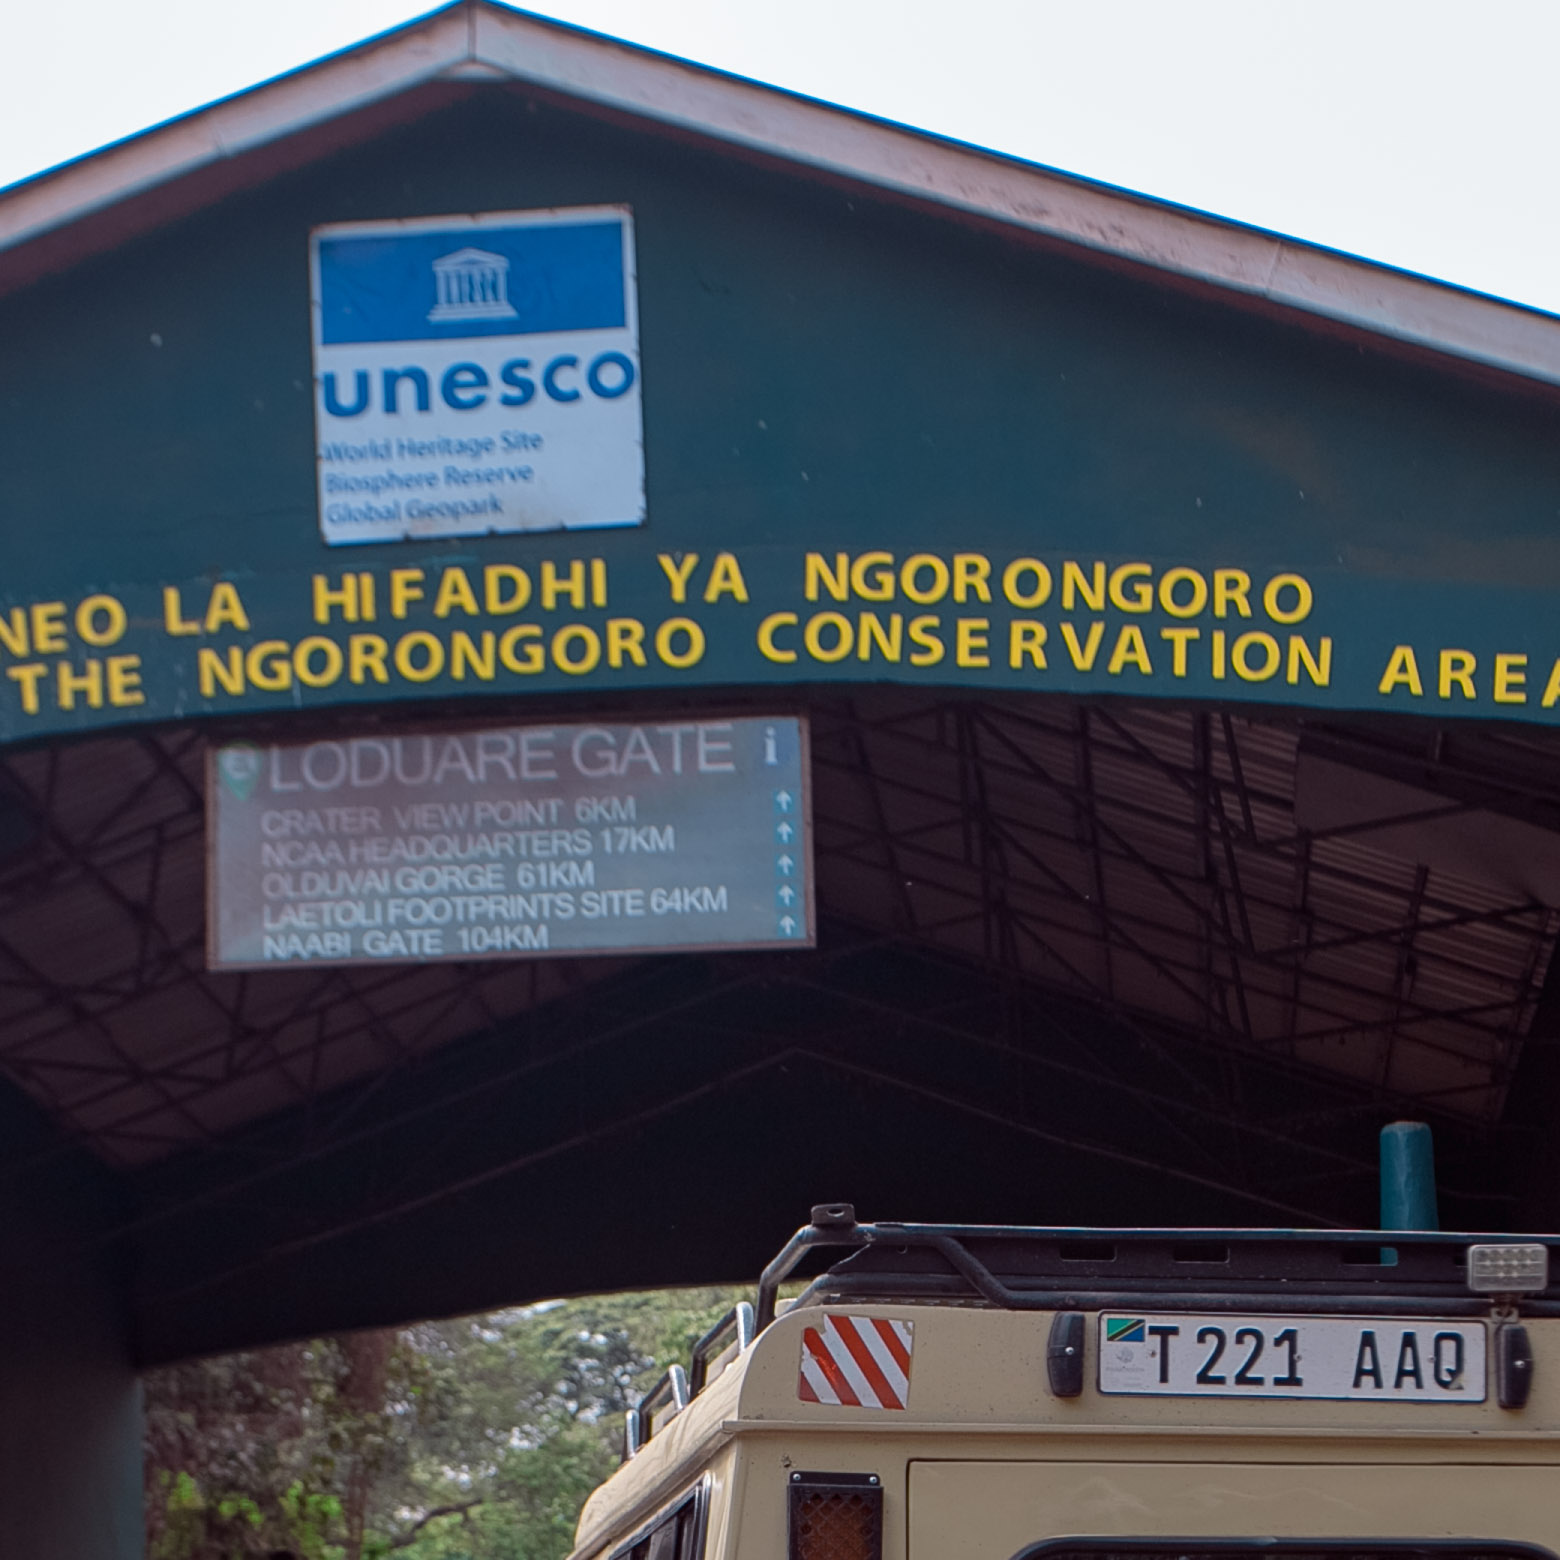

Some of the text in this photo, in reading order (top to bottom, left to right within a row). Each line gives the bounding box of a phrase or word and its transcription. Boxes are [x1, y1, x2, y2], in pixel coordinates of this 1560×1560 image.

[323, 352, 636, 418] unesco
[323, 429, 544, 463] World Heritage Site
[326, 464, 535, 496] Biosphere Reserve
[326, 493, 504, 524] Global Geopark
[163, 582, 251, 636] LA
[312, 558, 608, 625] HIFADHI
[657, 553, 750, 604] YA
[804, 551, 1314, 625] NGORONGORO
[6, 656, 146, 715] THE
[198, 616, 707, 698] NGORONGORO
[757, 612, 1334, 687] CONSERVATION
[269, 729, 558, 792] LODUARE
[571, 722, 736, 778] GATE
[260, 794, 637, 838] CRATER VIEW POINT 6KM
[261, 823, 675, 868] NCAA HEADQUARTERS 17KM
[261, 859, 595, 900] OLDUVAI GORGE 61KM
[262, 884, 729, 931] LAETOLI FOOTPRINTS SITE 64KM
[263, 923, 549, 960] NAABI GATE 104KM
[1196, 1326, 1304, 1387] 221
[1352, 1330, 1465, 1391] AAQ
